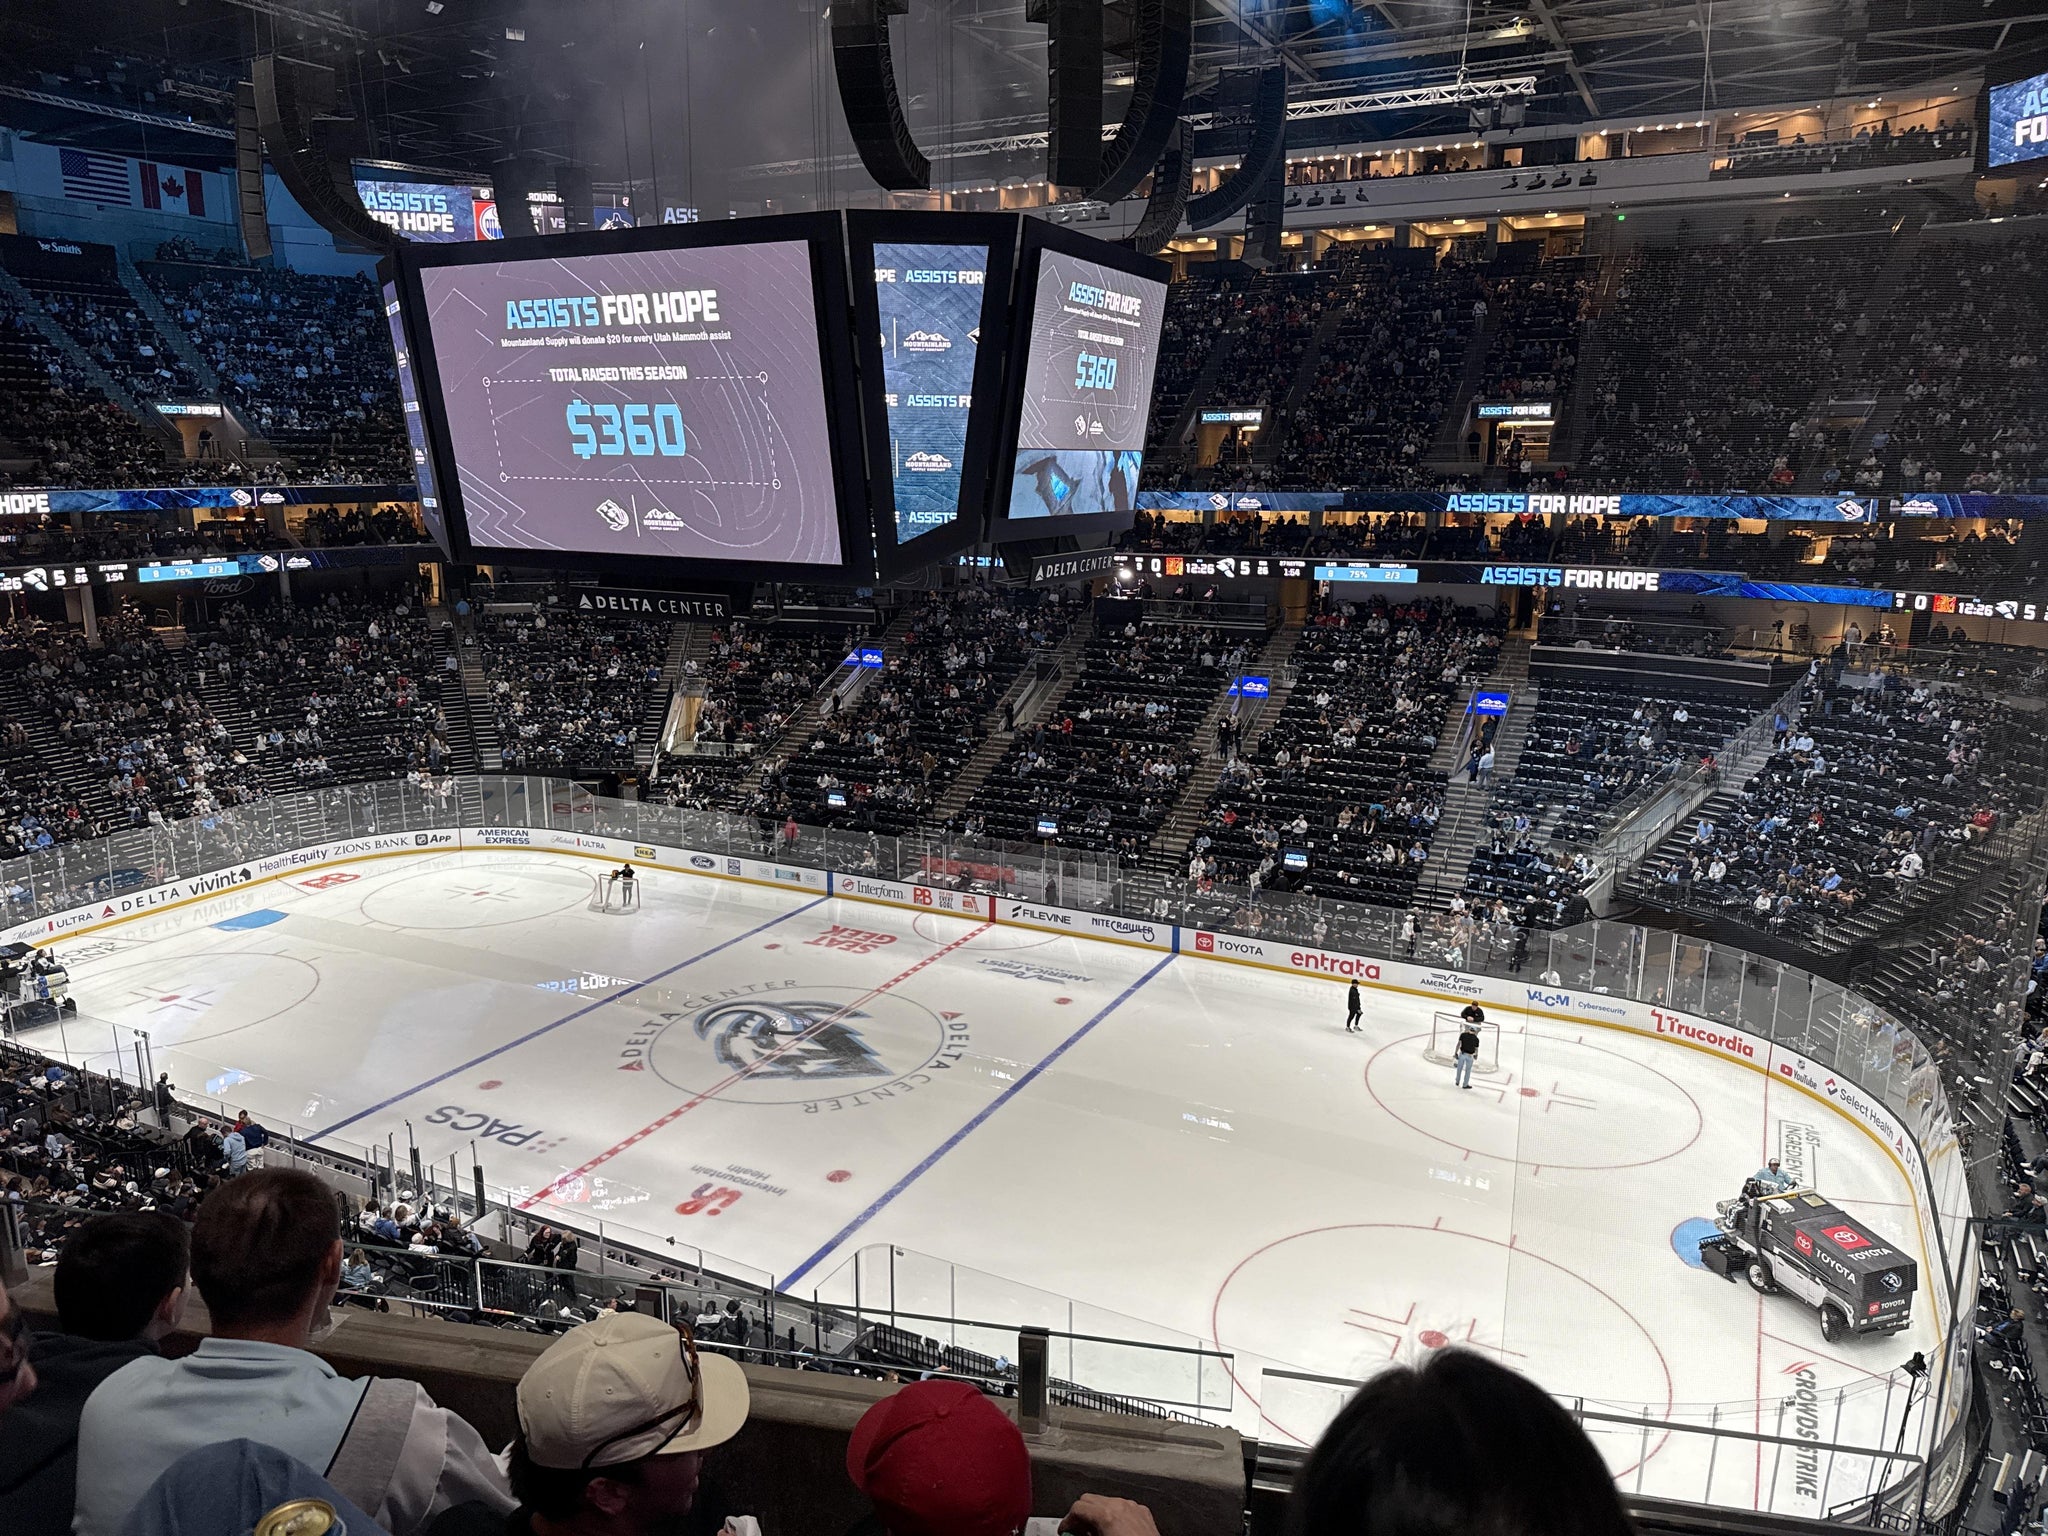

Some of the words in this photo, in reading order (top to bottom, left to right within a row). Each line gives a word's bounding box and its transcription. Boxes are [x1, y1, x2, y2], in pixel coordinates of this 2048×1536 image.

[365, 191, 447, 213] ASSISTS
[403, 212, 454, 233] HOPE
[550, 216, 565, 228] VS
[51, 242, 82, 254] Smith's
[905, 270, 957, 284] ASSISTS
[958, 271, 984, 285] FOR
[1068, 281, 1105, 308] ASSISTS
[1104, 290, 1122, 312] FOR
[1120, 295, 1142, 317] HOPE
[506, 296, 600, 330] ASSISTS
[601, 293, 651, 325] FOR
[652, 289, 720, 323] HOPE
[501, 337, 544, 347] Mountainland
[545, 336, 568, 347] Supply
[569, 336, 581, 345] will
[582, 335, 605, 344] donate
[606, 333, 620, 345] $20
[621, 334, 632, 343] for
[633, 334, 653, 346] every
[653, 332, 671, 342] Utah
[672, 331, 708, 342] Mammoth
[709, 330, 731, 341] assist
[549, 368, 581, 381] TOTAL
[582, 367, 619, 381] RAISED
[619, 366, 644, 380] THIS
[644, 365, 687, 380] SEASON
[1074, 350, 1118, 390] $360
[187, 405, 201, 414] FOR
[201, 405, 222, 415] HOPE
[907, 395, 957, 408] ASSISTS
[1202, 412, 1230, 421] ASSISTS
[1230, 412, 1243, 421] FOR
[1243, 412, 1262, 421] HOPE
[1480, 406, 1512, 415] ASSISTS
[1512, 406, 1528, 415] FOR
[1529, 406, 1551, 415] HOPE
[566, 399, 686, 460] $360
[0, 493, 51, 514] HOPE
[1446, 495, 1525, 512] ASSISTS
[1528, 495, 1566, 513] FOR
[1569, 496, 1621, 515] HOPE
[908, 512, 958, 525] ASSISTS
[153, 569, 160, 579] 8
[174, 566, 193, 577] 75%
[208, 565, 223, 575] 2/3
[1046, 561, 1077, 578] DELTA
[1080, 555, 1113, 572] CENTER
[1150, 558, 1161, 572] 0
[1185, 562, 1215, 575] 12:26
[1240, 561, 1250, 575] 5
[1283, 568, 1301, 577] 1:54
[53, 570, 67, 587] 5
[75, 573, 88, 584] 26
[105, 571, 124, 582] 1:54
[1349, 570, 1368, 579] 75%
[1384, 571, 1400, 580] 2/3
[1480, 566, 1561, 585] ASSISTS
[1564, 569, 1604, 588] FOR
[1607, 571, 1659, 591] HOPE
[202, 576, 242, 594] Ford
[595, 596, 652, 612] DELTA
[658, 600, 724, 617] CENTER
[1914, 594, 1927, 611] 0
[1958, 602, 1994, 617] 12:26
[2024, 604, 2037, 621] 5
[477, 828, 529, 837] AMERICAN
[485, 836, 531, 845] EXPRESS
[333, 841, 371, 856] ZIONS
[374, 836, 409, 850] BANK
[582, 840, 606, 850] ULTRA
[635, 848, 655, 858] IKEA
[259, 848, 328, 873] HealthEquity
[693, 855, 714, 868] Ford
[121, 886, 181, 912] DELTA
[857, 881, 904, 900] Interform
[56, 912, 93, 929] ULTRA
[1022, 908, 1071, 925] FILEVINE
[819, 924, 898, 946] GEEK
[1091, 917, 1156, 943] NITECRAWLER
[802, 935, 881, 955] SEAT
[1217, 940, 1264, 957] TOYOTA
[977, 958, 1022, 974] FIRST
[1290, 951, 1381, 980] entrata
[1018, 965, 1095, 984] AMERICA
[1420, 978, 1458, 991] AMERICA
[1458, 984, 1485, 996] FIRST
[1577, 1000, 1627, 1017] Cybersecurity
[619, 1010, 681, 1059] DELTA
[682, 978, 799, 1010] CENTER
[928, 1021, 970, 1071] DELTA
[1666, 1016, 1754, 1059] Trucordia
[1793, 1067, 1818, 1091] YouTube
[802, 1072, 932, 1115] CENTER
[1839, 1088, 1870, 1118] Select
[1869, 1108, 1895, 1141] Health
[424, 1104, 543, 1148] PACS
[1805, 1121, 1821, 1148] JUST
[726, 1162, 772, 1180] Health
[689, 1164, 788, 1198] Intermountain
[1848, 1246, 1893, 1262] TOYOTA
[1815, 1247, 1858, 1285] TOYOTA
[1881, 1298, 1907, 1311] TOYOTA
[1795, 1368, 1820, 1500] CROWDSTRIKE
